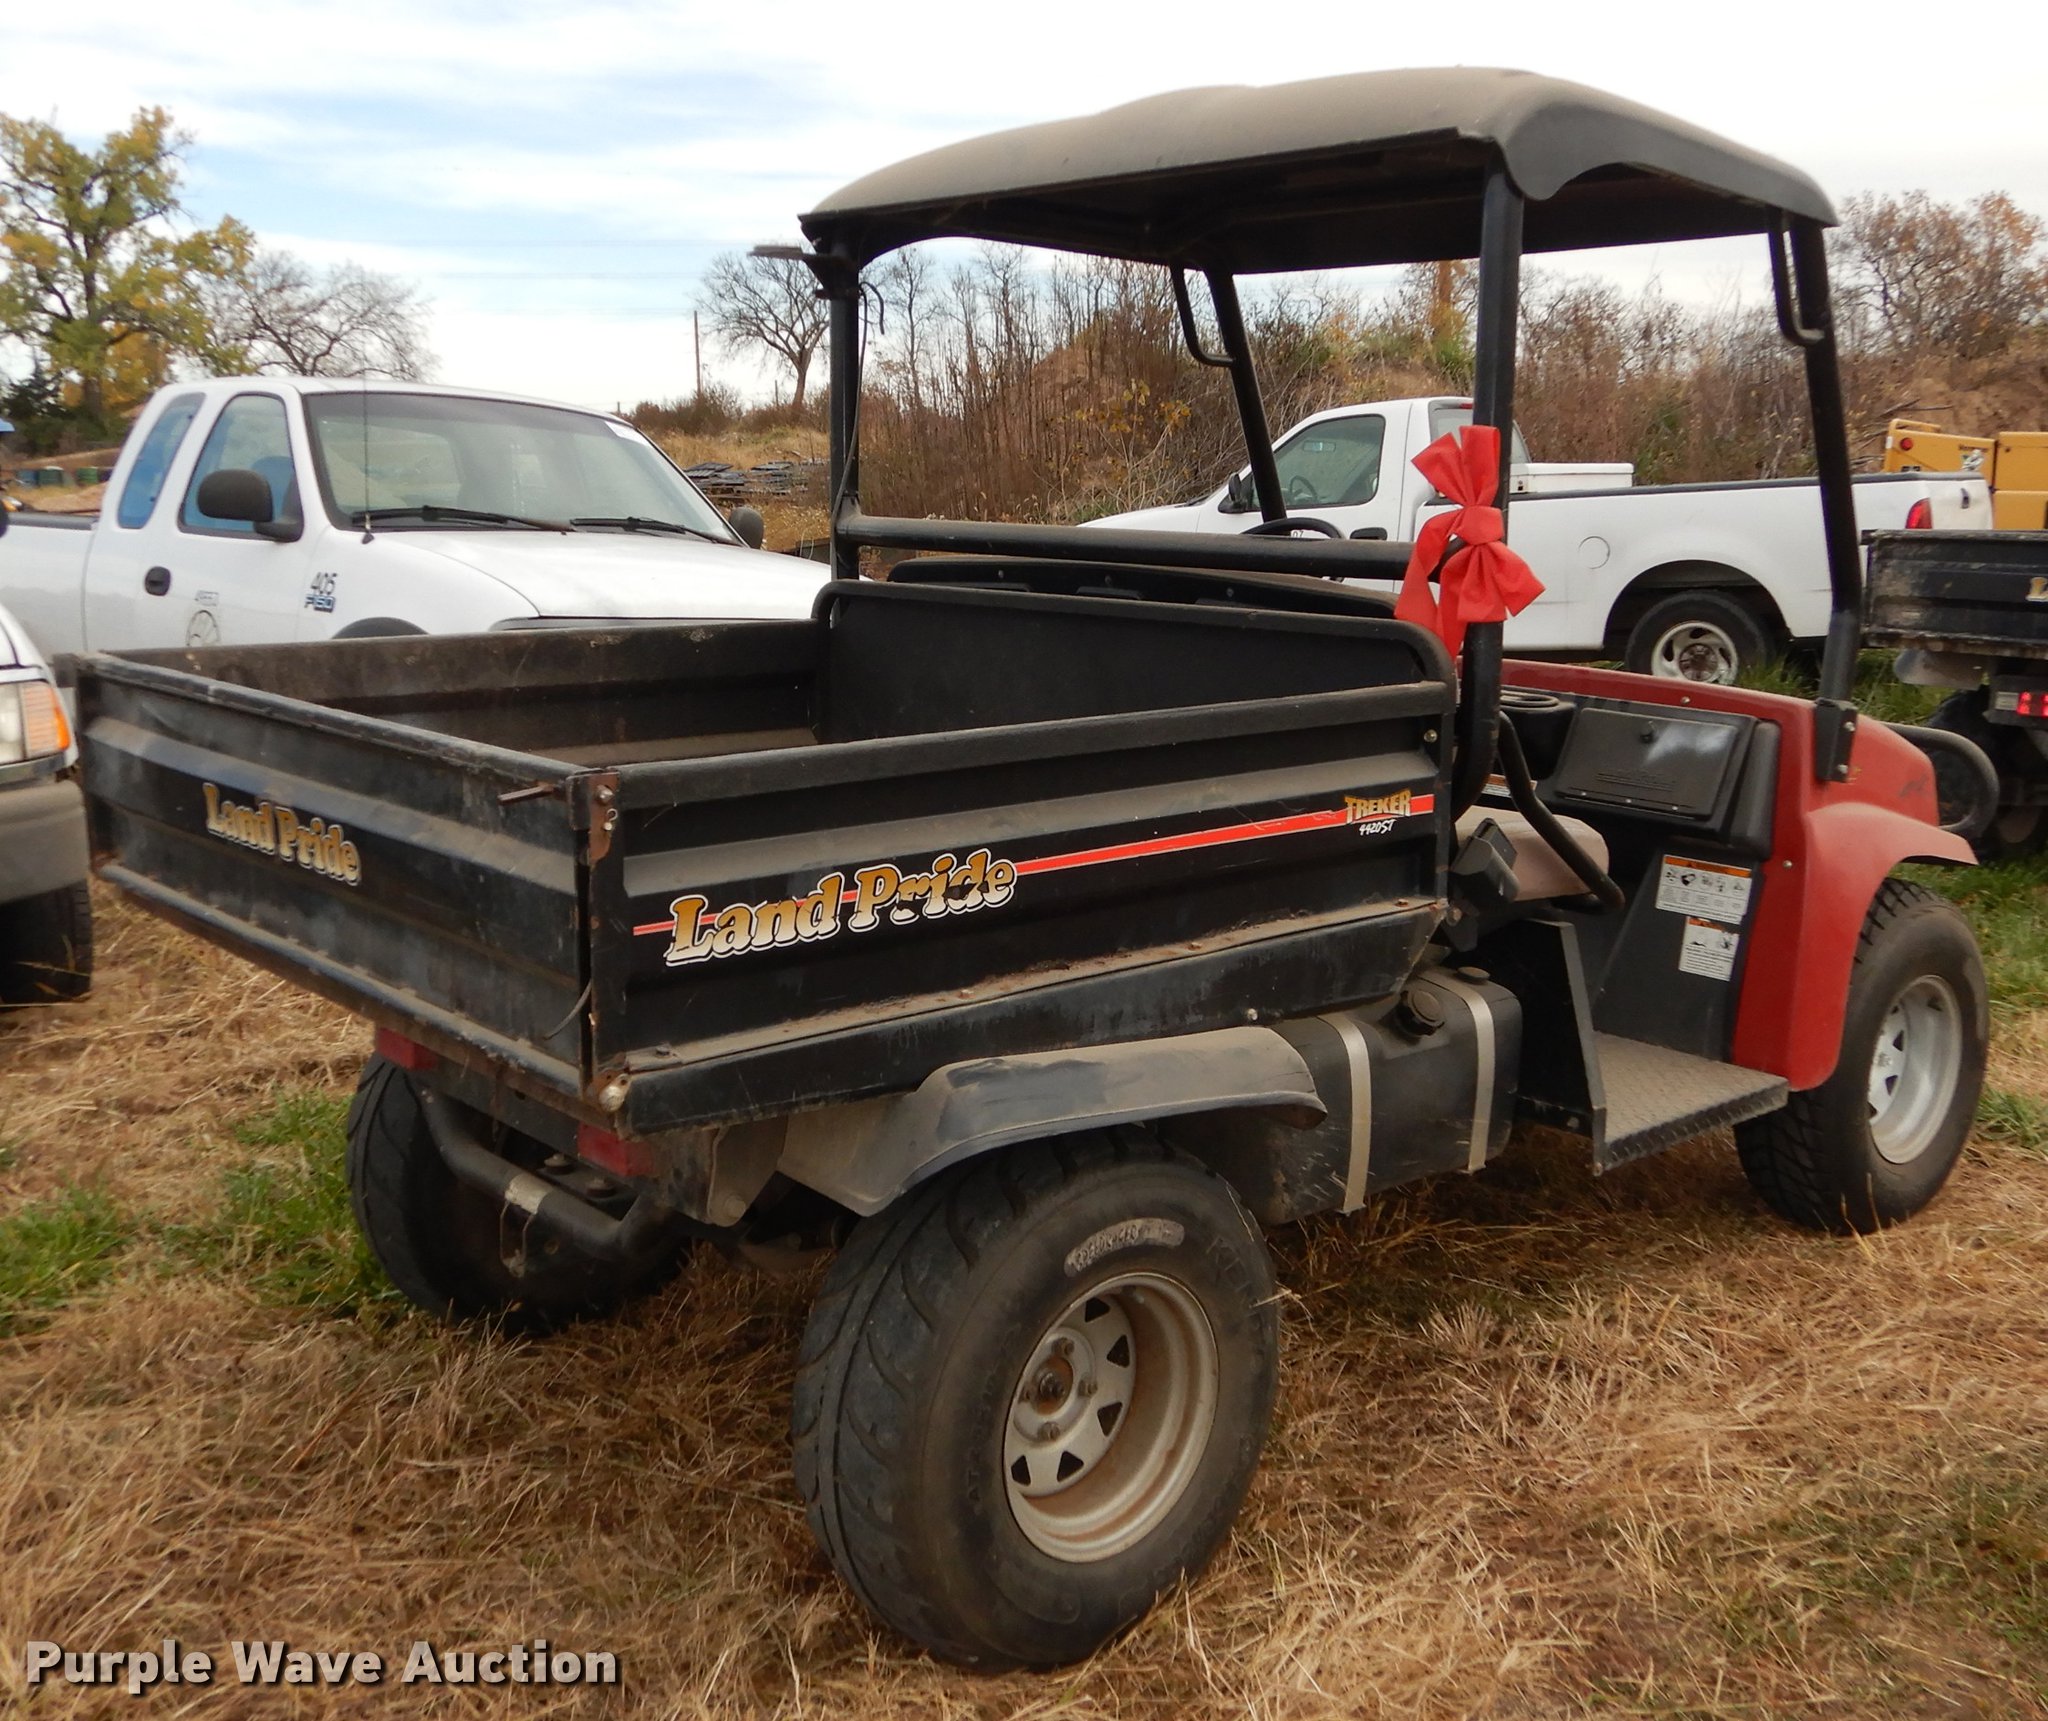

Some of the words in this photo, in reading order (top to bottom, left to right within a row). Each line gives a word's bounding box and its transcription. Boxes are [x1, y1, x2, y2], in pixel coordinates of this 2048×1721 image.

[310, 571, 338, 596] 405
[1344, 788, 1412, 825] TREKER
[202, 782, 276, 856] Land
[275, 806, 362, 886] Pride
[1359, 819, 1397, 836] 4420ST
[664, 872, 845, 967] Land
[848, 848, 1017, 932] Pride
